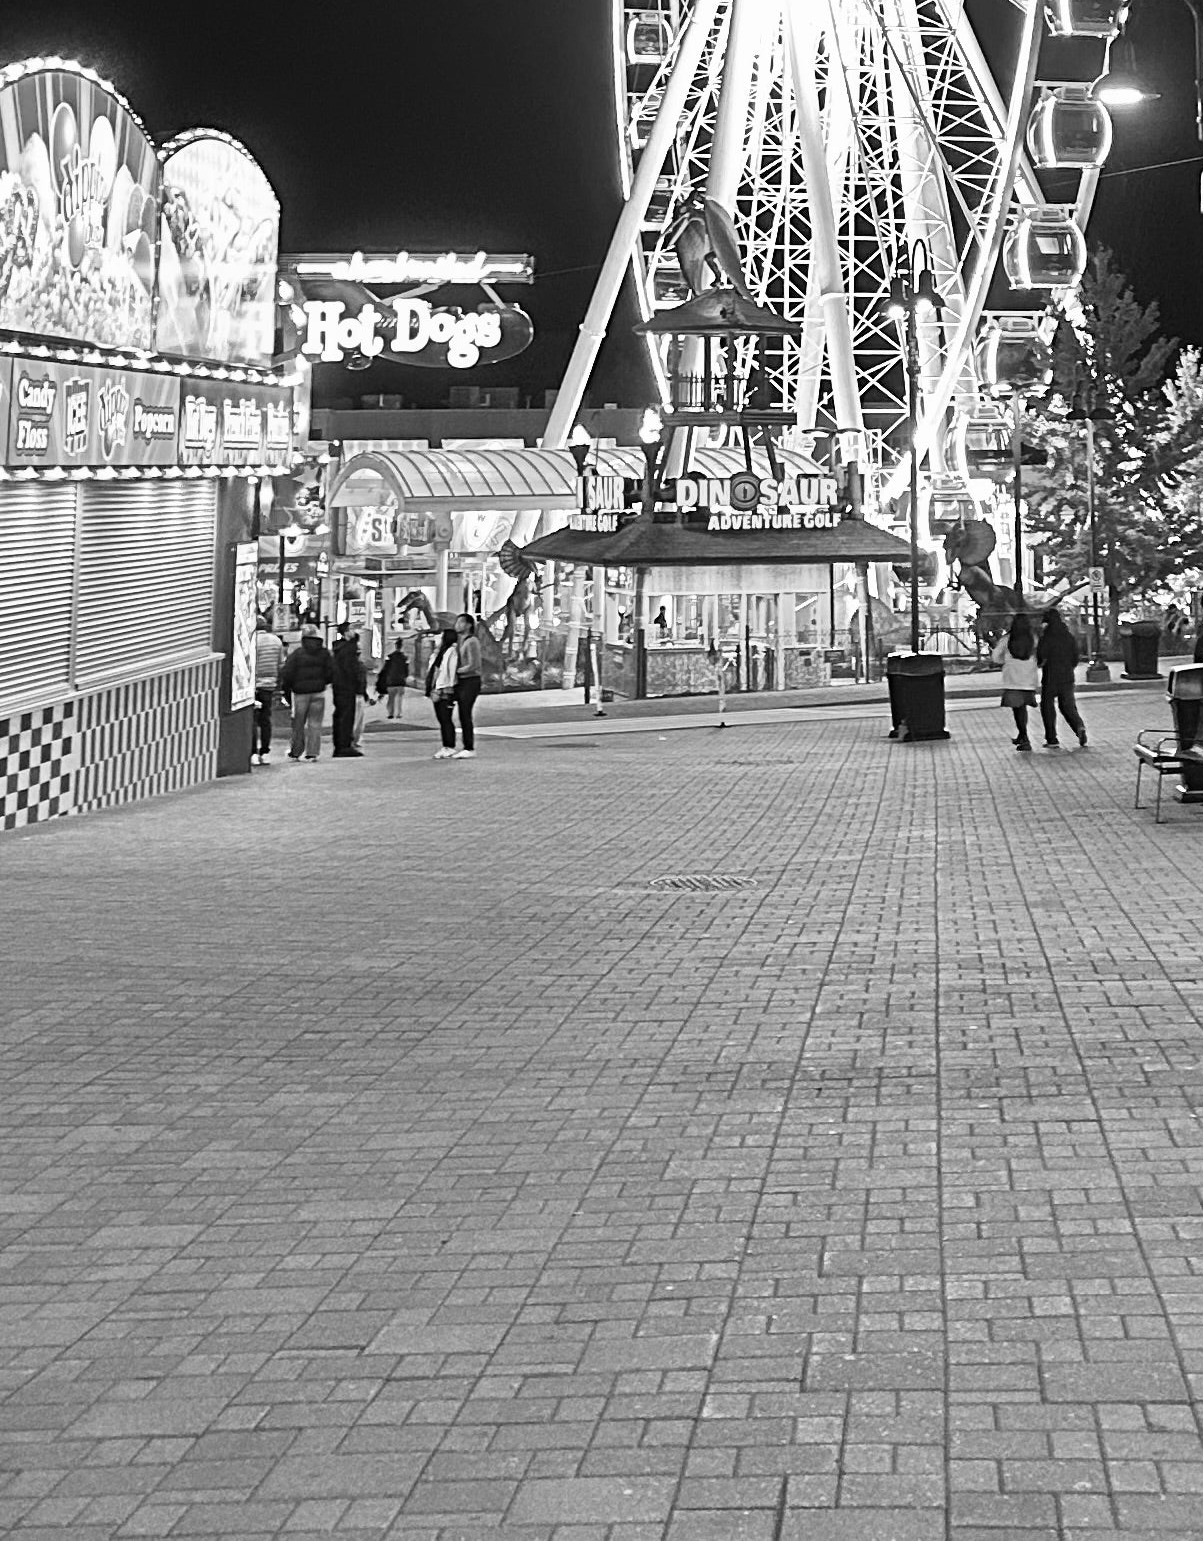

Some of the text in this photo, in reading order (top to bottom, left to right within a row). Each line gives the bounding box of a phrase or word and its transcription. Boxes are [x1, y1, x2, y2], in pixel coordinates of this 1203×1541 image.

[302, 298, 502, 369] Hot Dogs
[19, 378, 55, 414] Candy
[16, 420, 48, 449] Floss
[134, 403, 175, 438] Popcorn
[676, 472, 839, 511] DINOSAUR
[597, 514, 618, 532] GOLF
[707, 512, 841, 531] ADVENTURE GOLF
